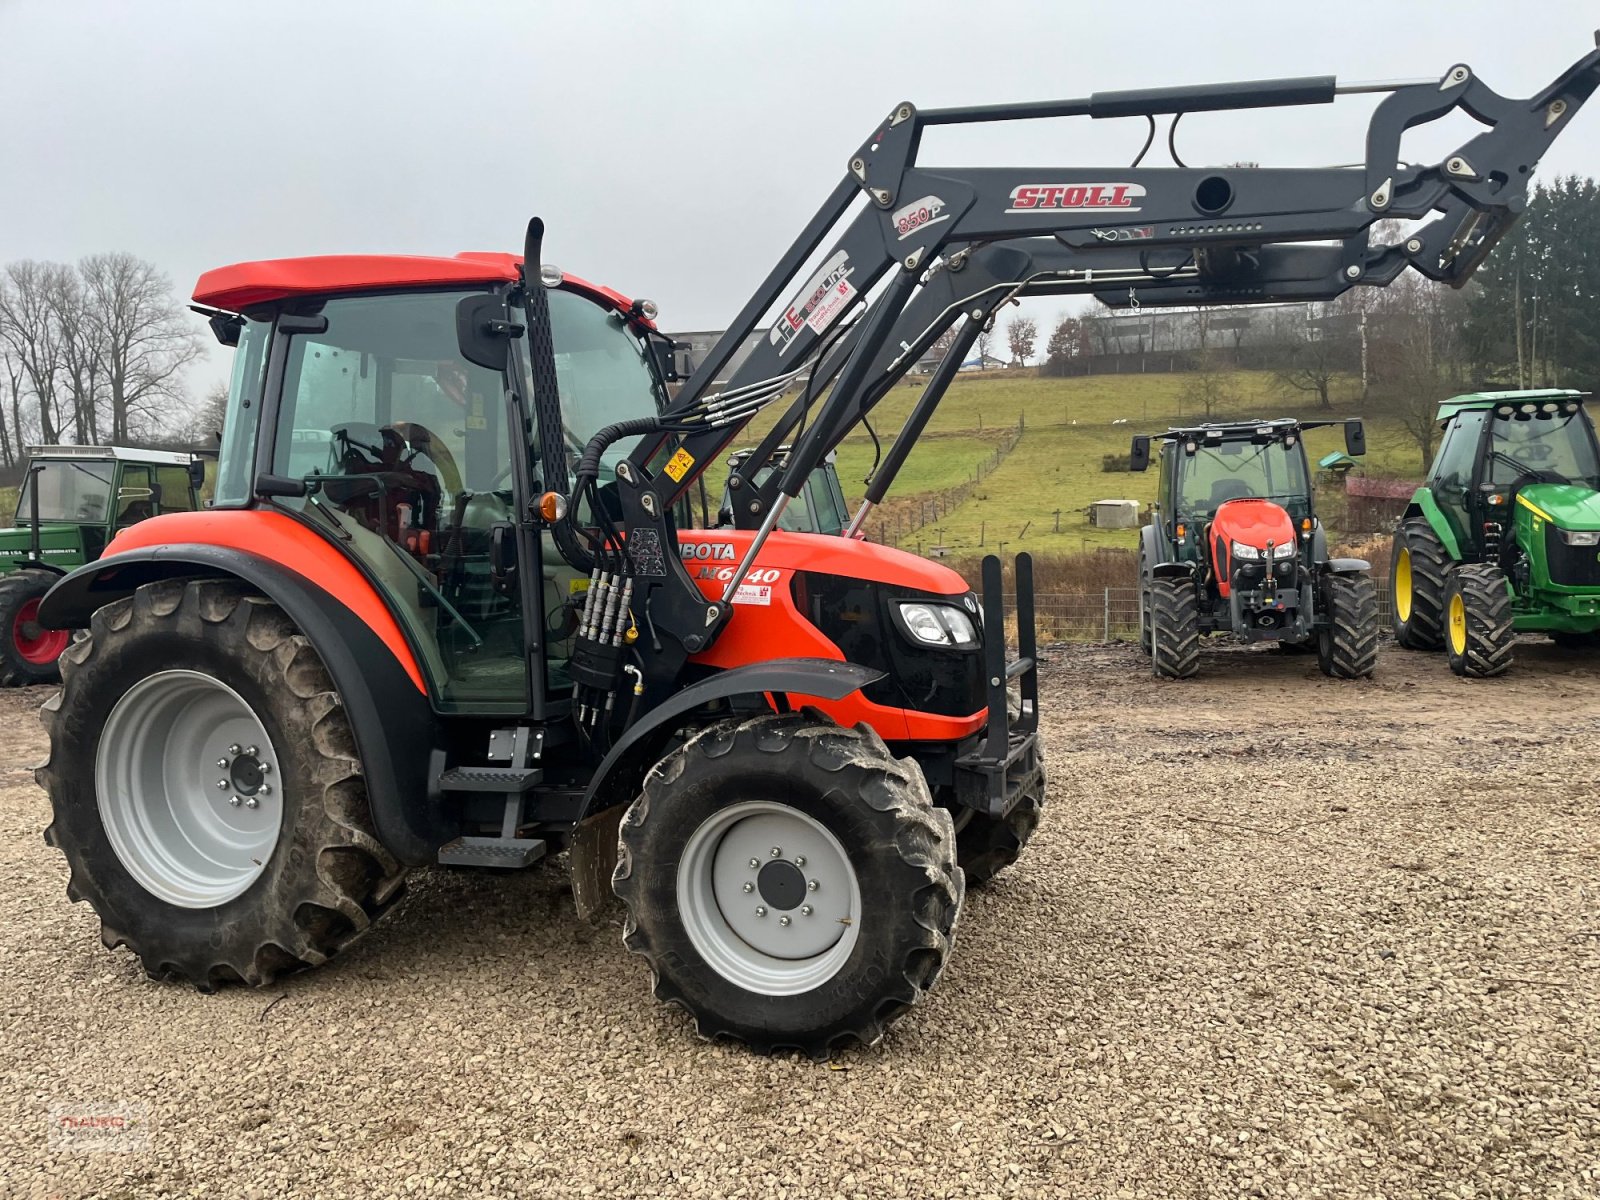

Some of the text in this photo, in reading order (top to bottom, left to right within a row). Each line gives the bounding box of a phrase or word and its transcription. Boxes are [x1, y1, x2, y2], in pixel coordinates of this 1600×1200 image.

[1013, 185, 1132, 208] STOLL
[898, 203, 941, 234] 850 P
[694, 566, 780, 583] M640
